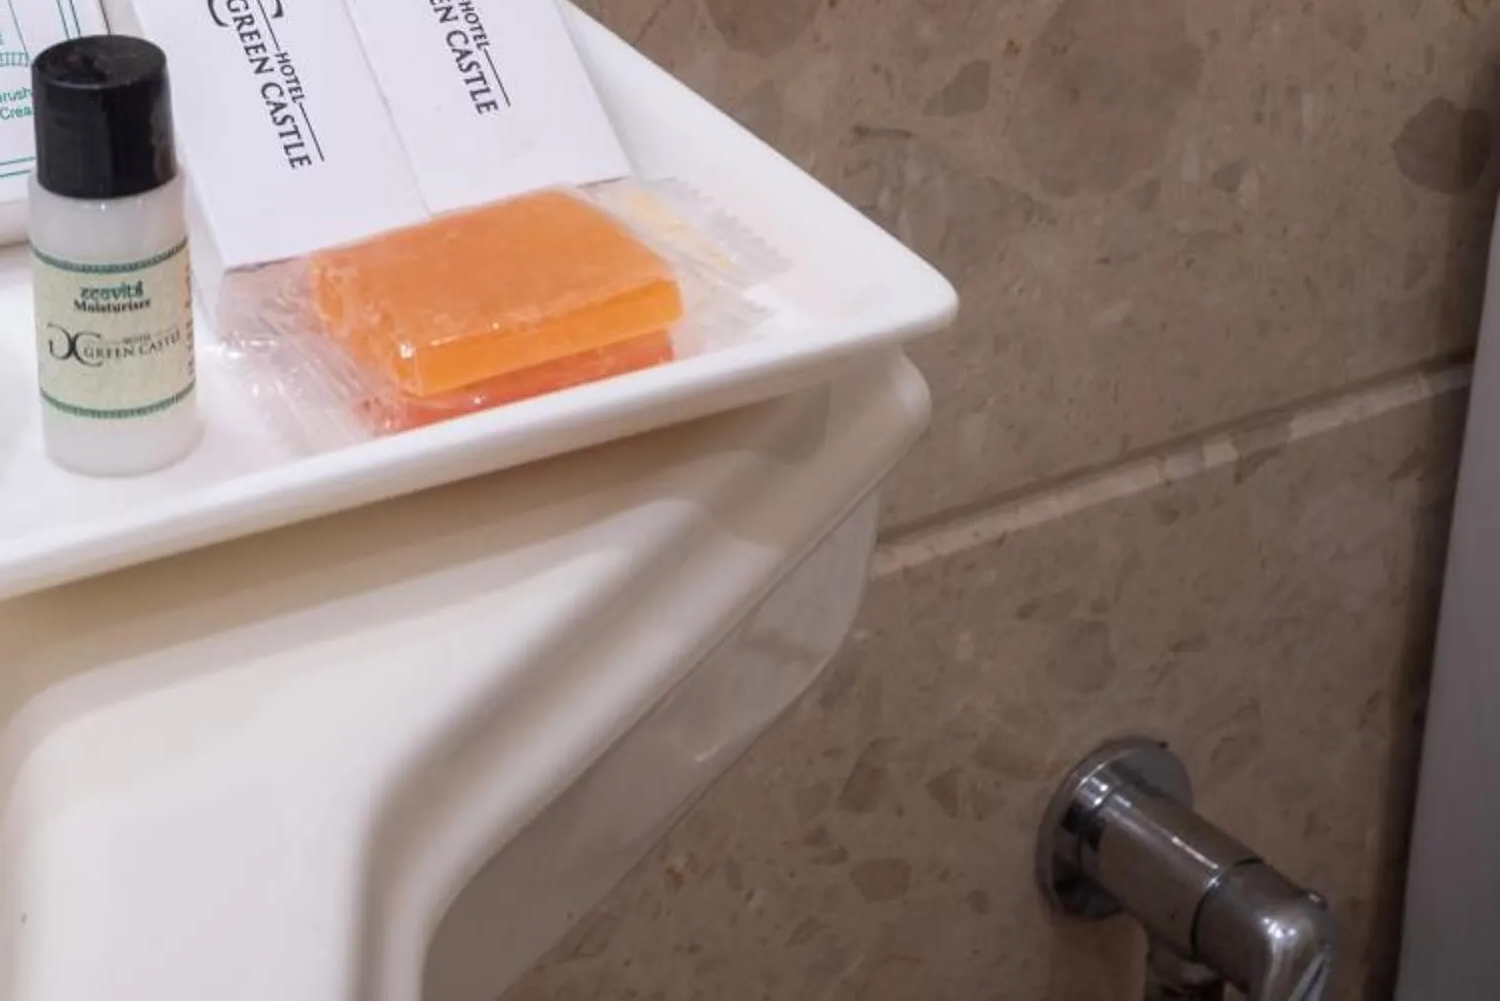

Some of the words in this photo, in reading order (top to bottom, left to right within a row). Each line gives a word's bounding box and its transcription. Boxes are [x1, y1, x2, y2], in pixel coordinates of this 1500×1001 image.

[458, 0, 491, 50] HOTEL
[275, 50, 307, 104] HOTEL
[445, 29, 499, 115] CASTLE
[0, 106, 37, 121] Crea
[260, 80, 313, 169] CASTLE
